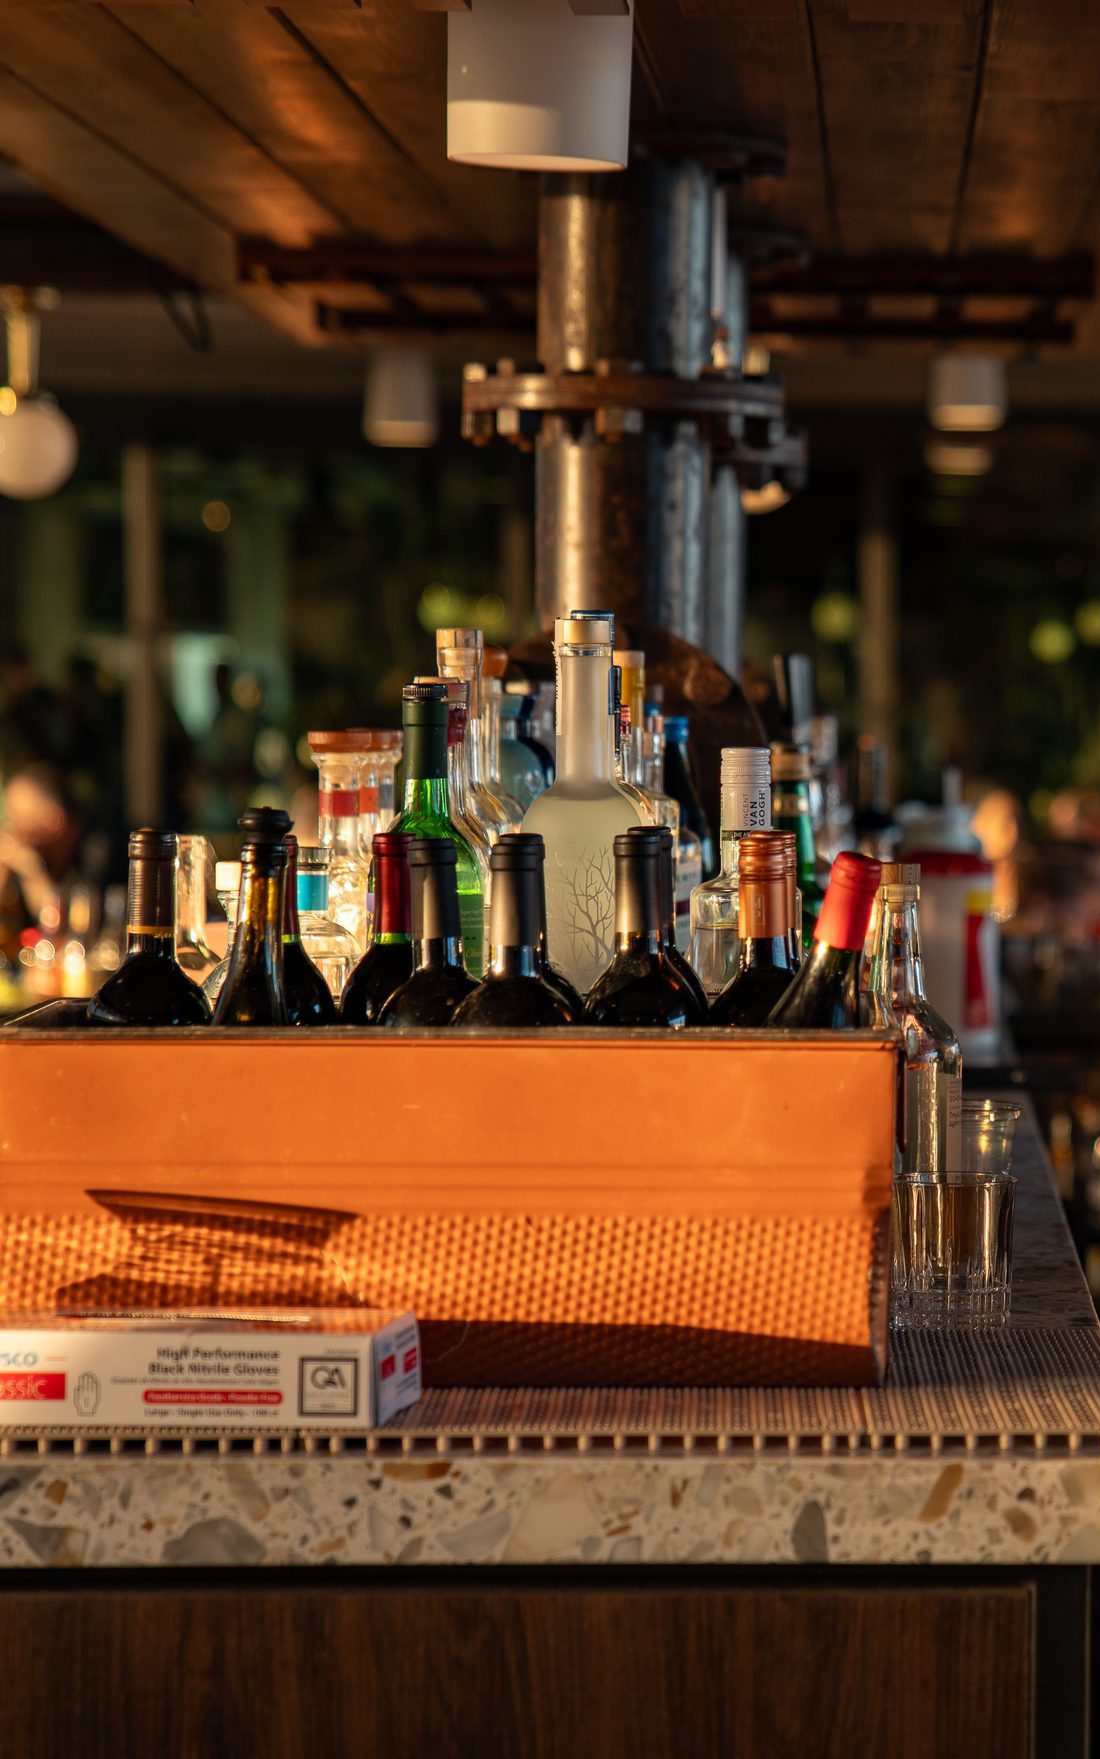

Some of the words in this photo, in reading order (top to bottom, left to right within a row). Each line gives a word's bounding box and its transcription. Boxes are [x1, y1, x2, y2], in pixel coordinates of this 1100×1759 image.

[750, 801, 758, 827] VAN
[157, 1347, 189, 1361] High
[192, 1348, 280, 1361] Performance
[148, 1362, 184, 1375] Black
[188, 1362, 231, 1375] Nitrile
[233, 1362, 280, 1376] Gloves
